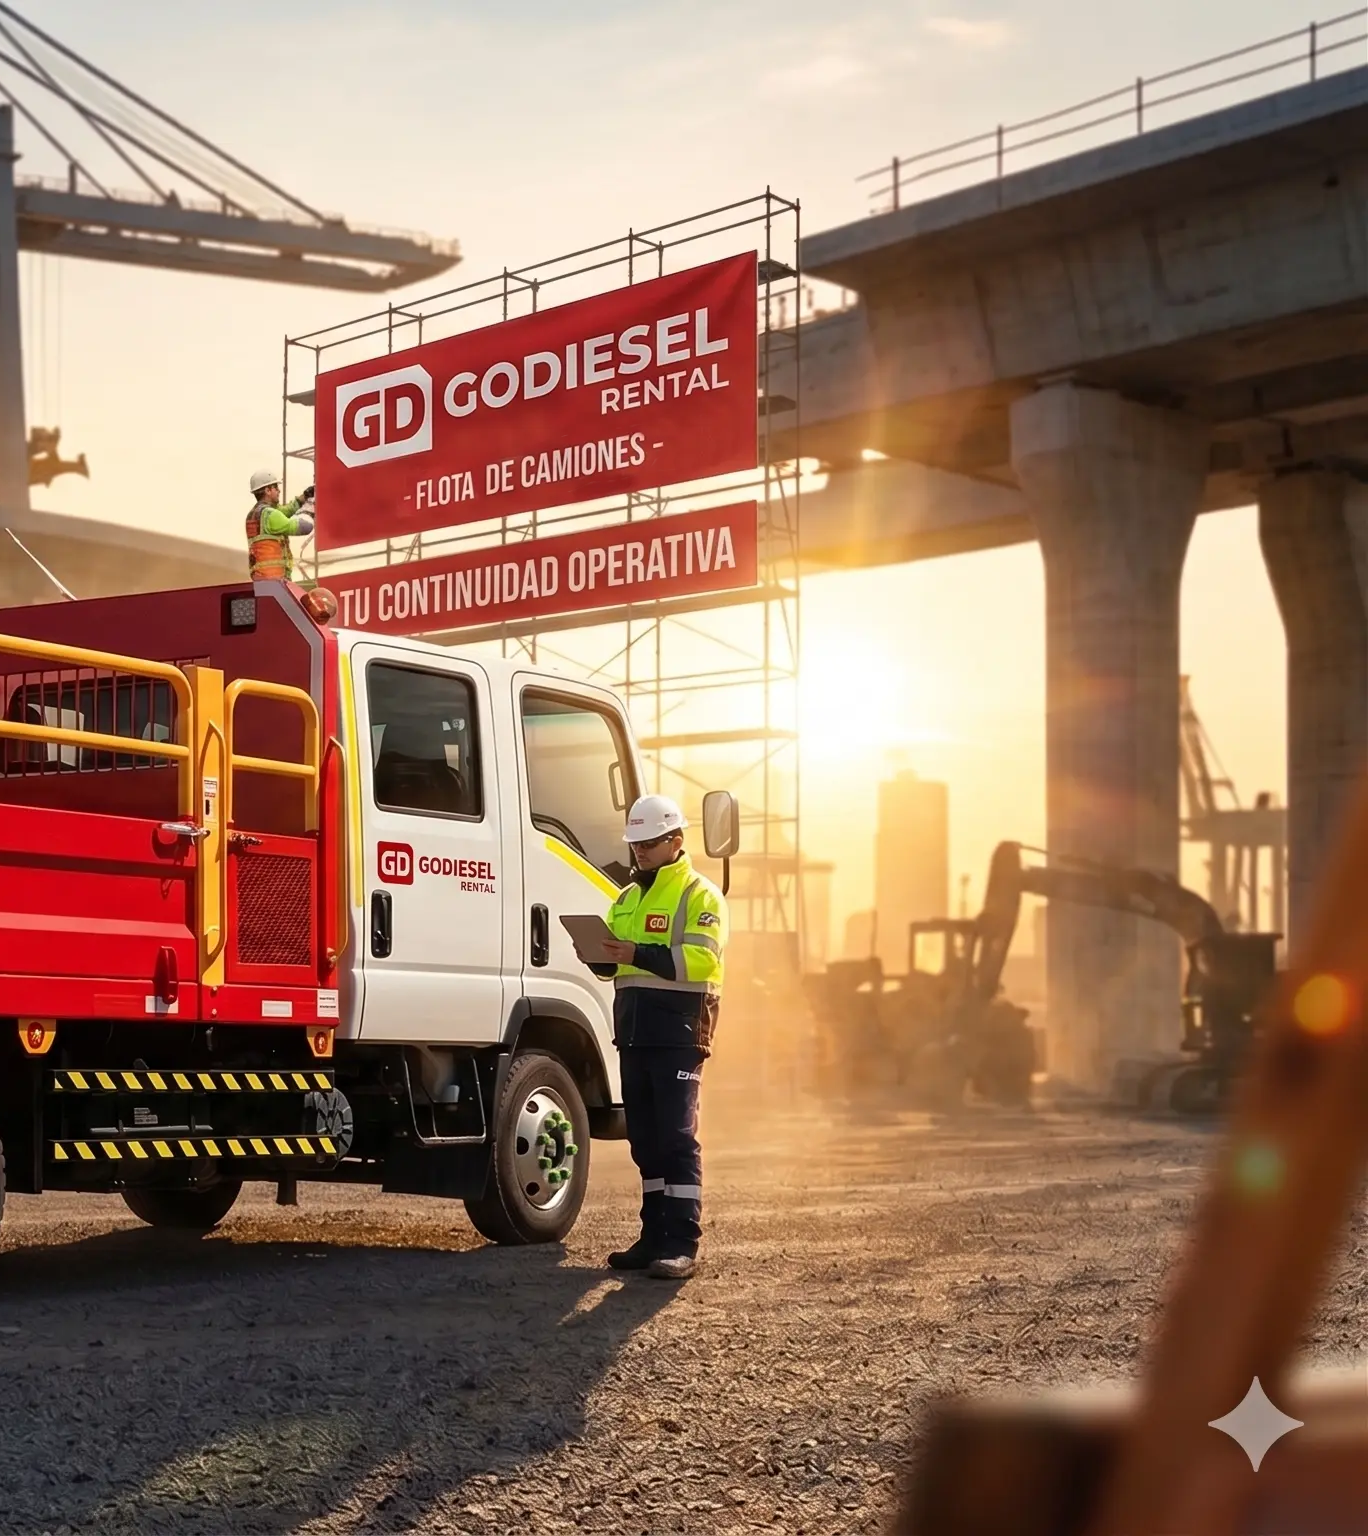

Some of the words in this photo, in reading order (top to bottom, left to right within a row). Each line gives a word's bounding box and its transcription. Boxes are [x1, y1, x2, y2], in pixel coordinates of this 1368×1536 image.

[340, 380, 428, 454] GD
[443, 307, 729, 418] GODIESEL
[601, 363, 730, 415] RENTAL
[486, 459, 515, 495] DE
[521, 432, 646, 488] CAMIONES
[339, 587, 370, 627] TU
[378, 556, 559, 622] CONTINUIDAD
[568, 526, 736, 592] OPERATIVA
[380, 849, 412, 878] GD
[418, 855, 496, 881] GODIESEL
[460, 881, 496, 894] RENTAL
